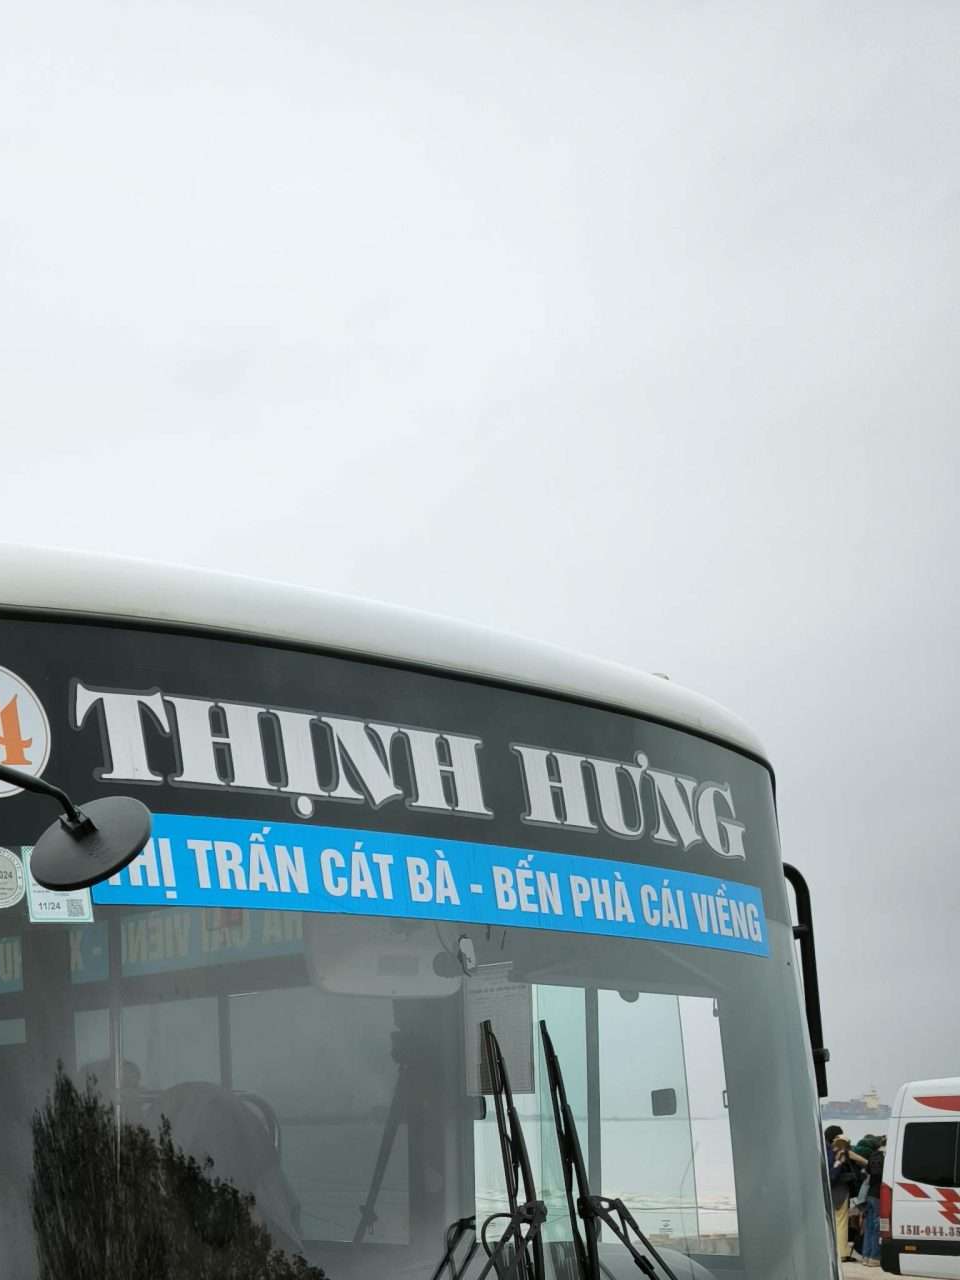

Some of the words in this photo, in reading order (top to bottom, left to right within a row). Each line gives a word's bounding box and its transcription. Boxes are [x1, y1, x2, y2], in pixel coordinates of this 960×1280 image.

[75, 681, 494, 818] THỊNH
[511, 752, 746, 860] HƯNG
[38, 901, 62, 912] 11/24
[187, 826, 310, 895] TRẤN
[320, 841, 395, 901] CÁT
[405, 849, 461, 906] BÀ
[493, 854, 565, 916] BẾN
[569, 871, 636, 923] PHÀ
[641, 878, 689, 930] CÁI
[691, 882, 764, 942] VIỀNG
